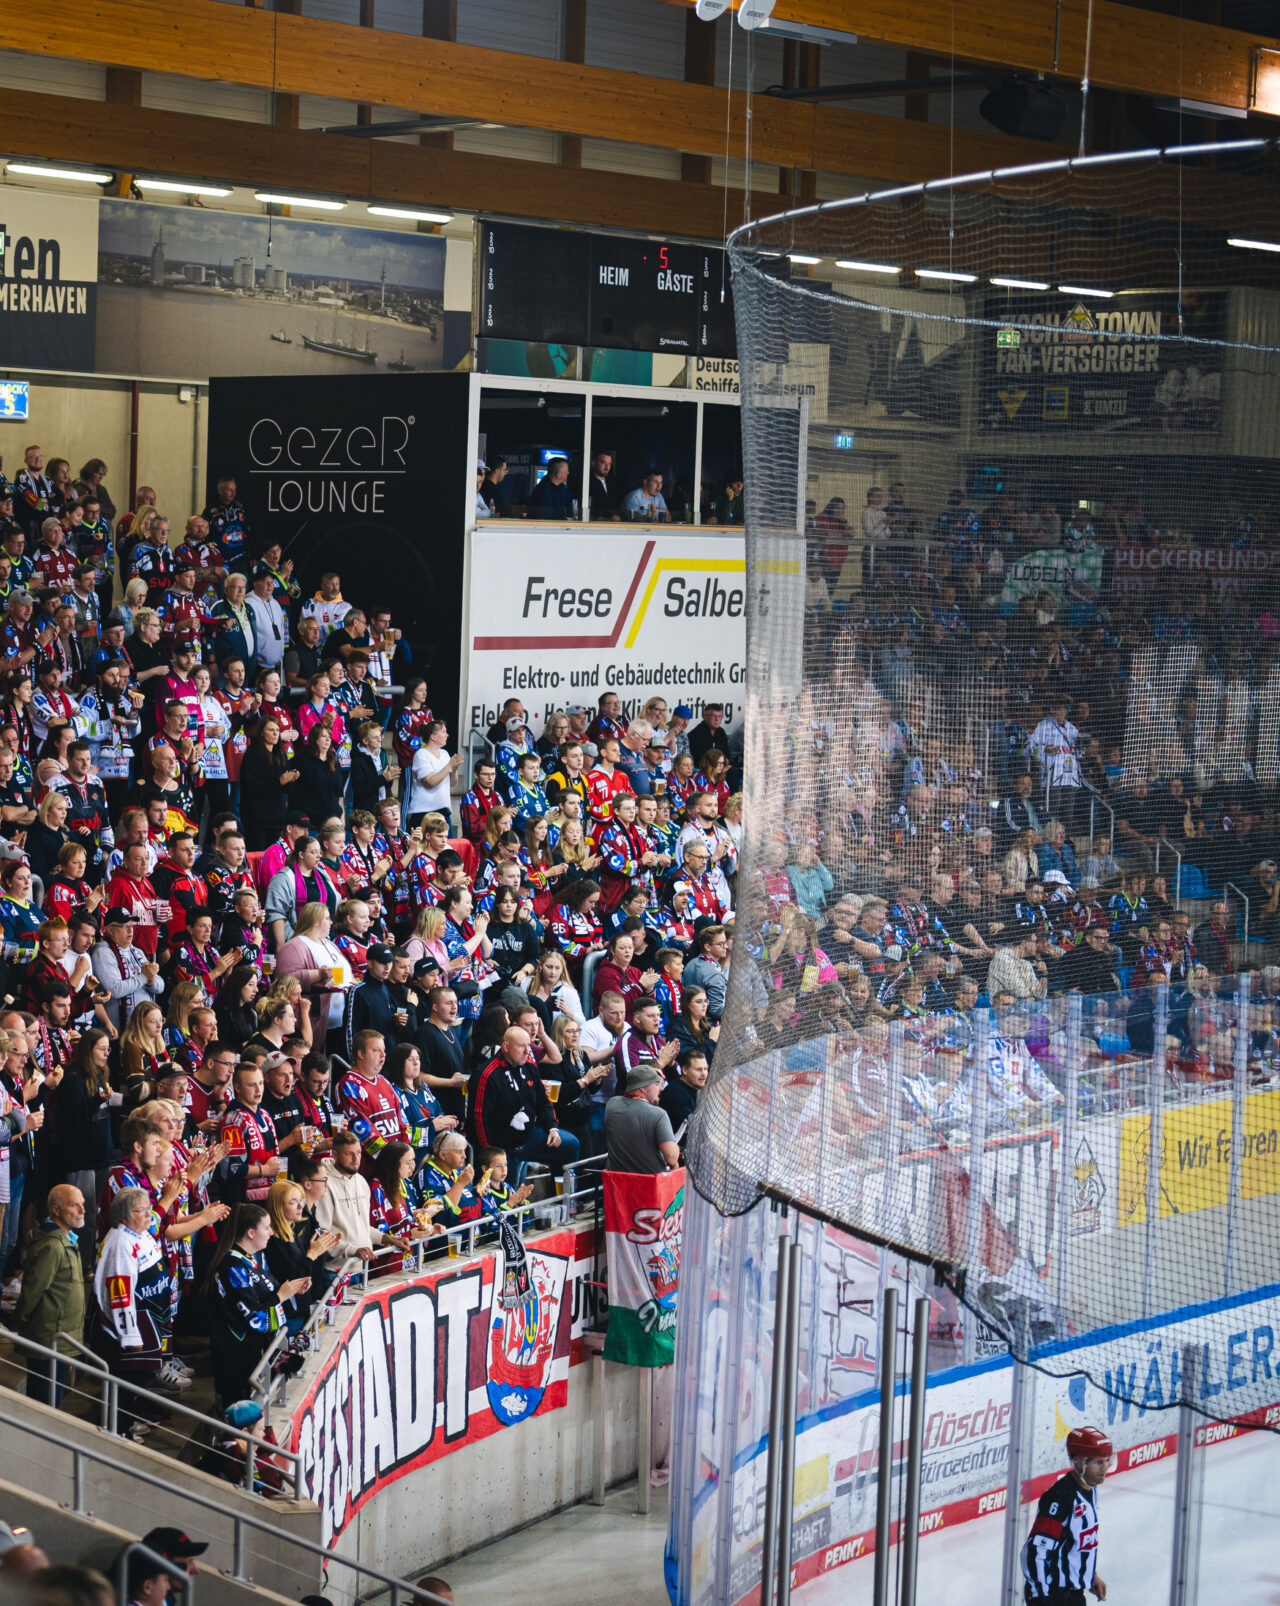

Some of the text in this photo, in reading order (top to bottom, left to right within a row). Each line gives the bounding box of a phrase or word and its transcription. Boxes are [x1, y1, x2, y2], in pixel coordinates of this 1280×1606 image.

[659, 246, 669, 269] 5
[599, 265, 629, 287] HEIM
[657, 269, 694, 294] GÄSTE
[1095, 311, 1162, 343] TOWN
[696, 357, 740, 374] Deutsc
[996, 344, 1160, 373] FAN-VERSORGER
[4, 395, 16, 415] 5
[267, 480, 386, 513] LOUNGE
[523, 574, 747, 619] Frese Salbe
[503, 665, 565, 690] Elektro-
[570, 663, 599, 687] und
[606, 661, 725, 687] Gebäudetechnik
[551, 922, 566, 934] 26
[246, 1118, 261, 1150] 2019
[1177, 1136, 1211, 1172] Wir
[372, 1207, 385, 1221] 91
[923, 1398, 1012, 1451] Dösche
[1128, 1439, 1168, 1467] PENNY.
[978, 1489, 1008, 1515] PENN
[1048, 1501, 1059, 1516] 6
[824, 1536, 865, 1570] PENNY.
